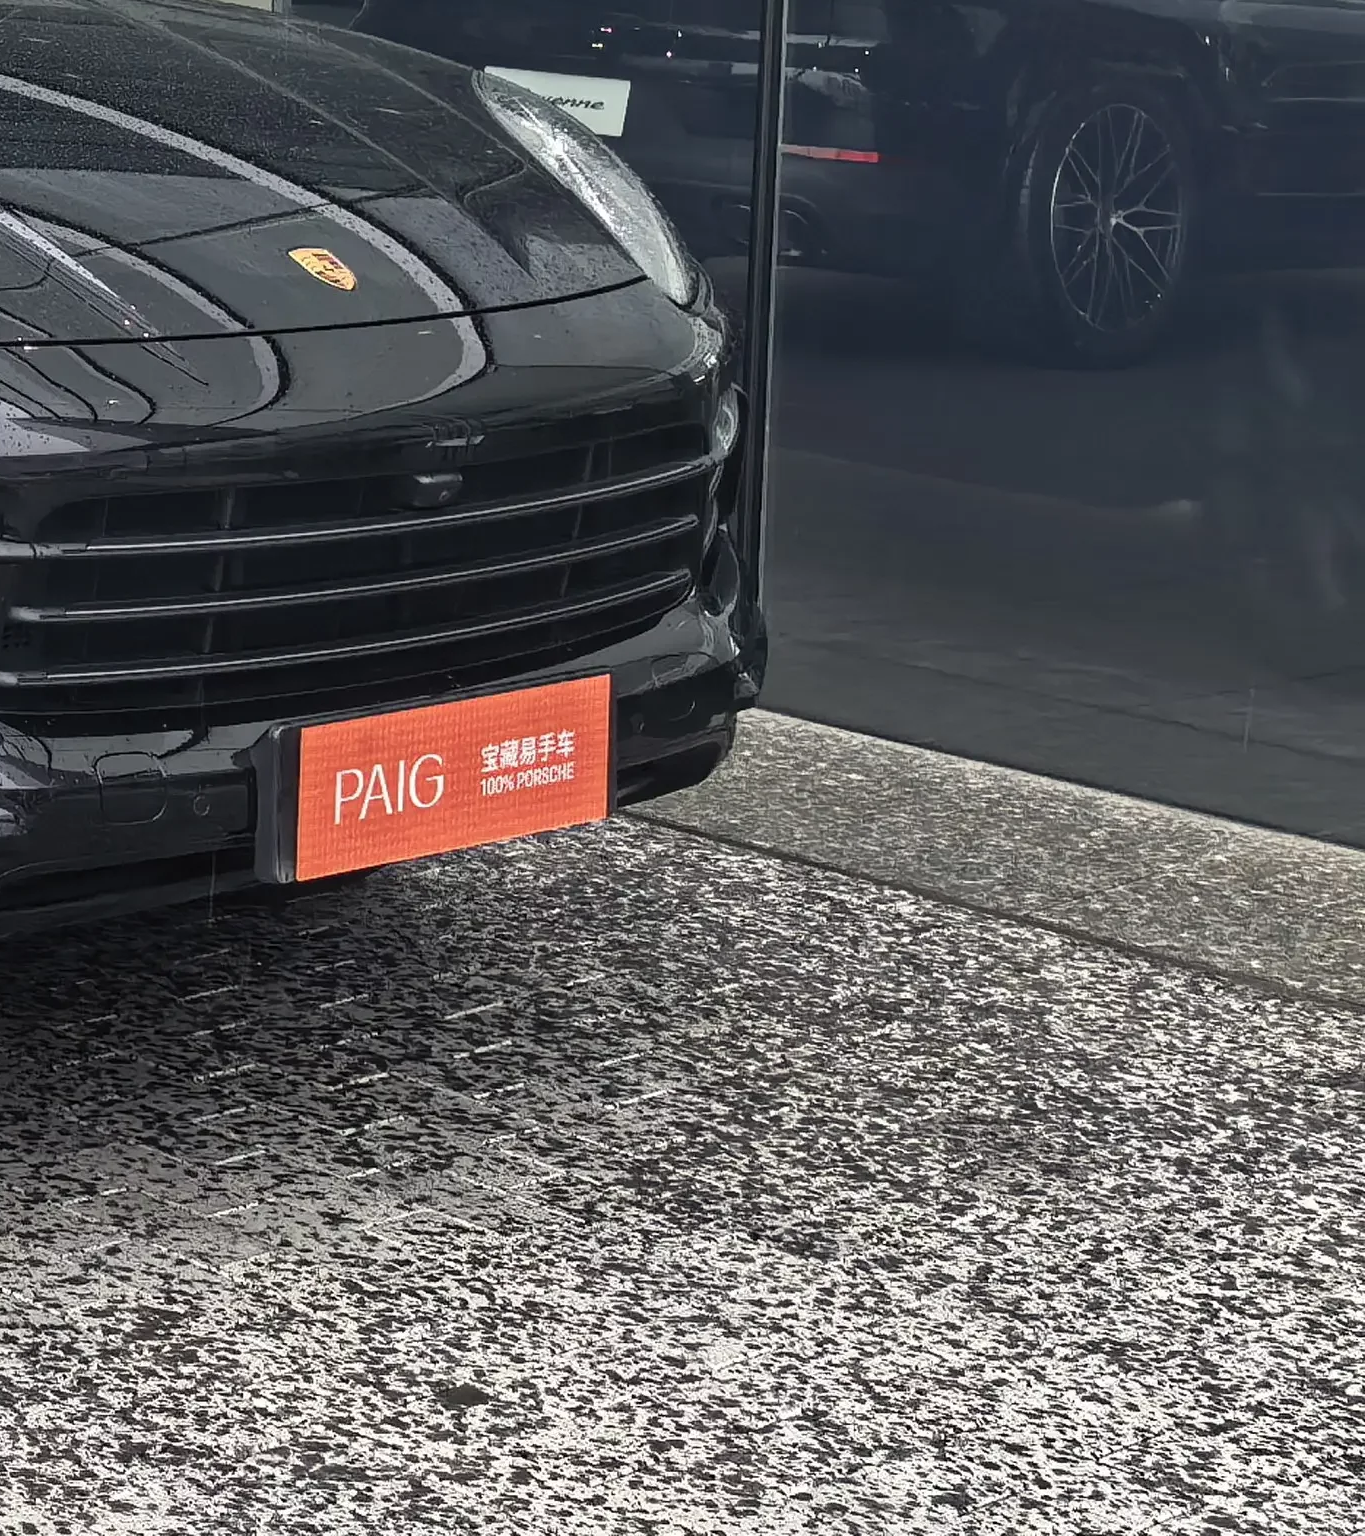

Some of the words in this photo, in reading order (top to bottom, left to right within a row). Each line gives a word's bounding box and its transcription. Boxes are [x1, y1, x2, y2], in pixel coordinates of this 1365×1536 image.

[480, 728, 575, 773] 宝藏易手车
[334, 753, 445, 826] PAIG
[480, 774, 515, 797] 100%
[515, 760, 576, 790] PORSCHE
